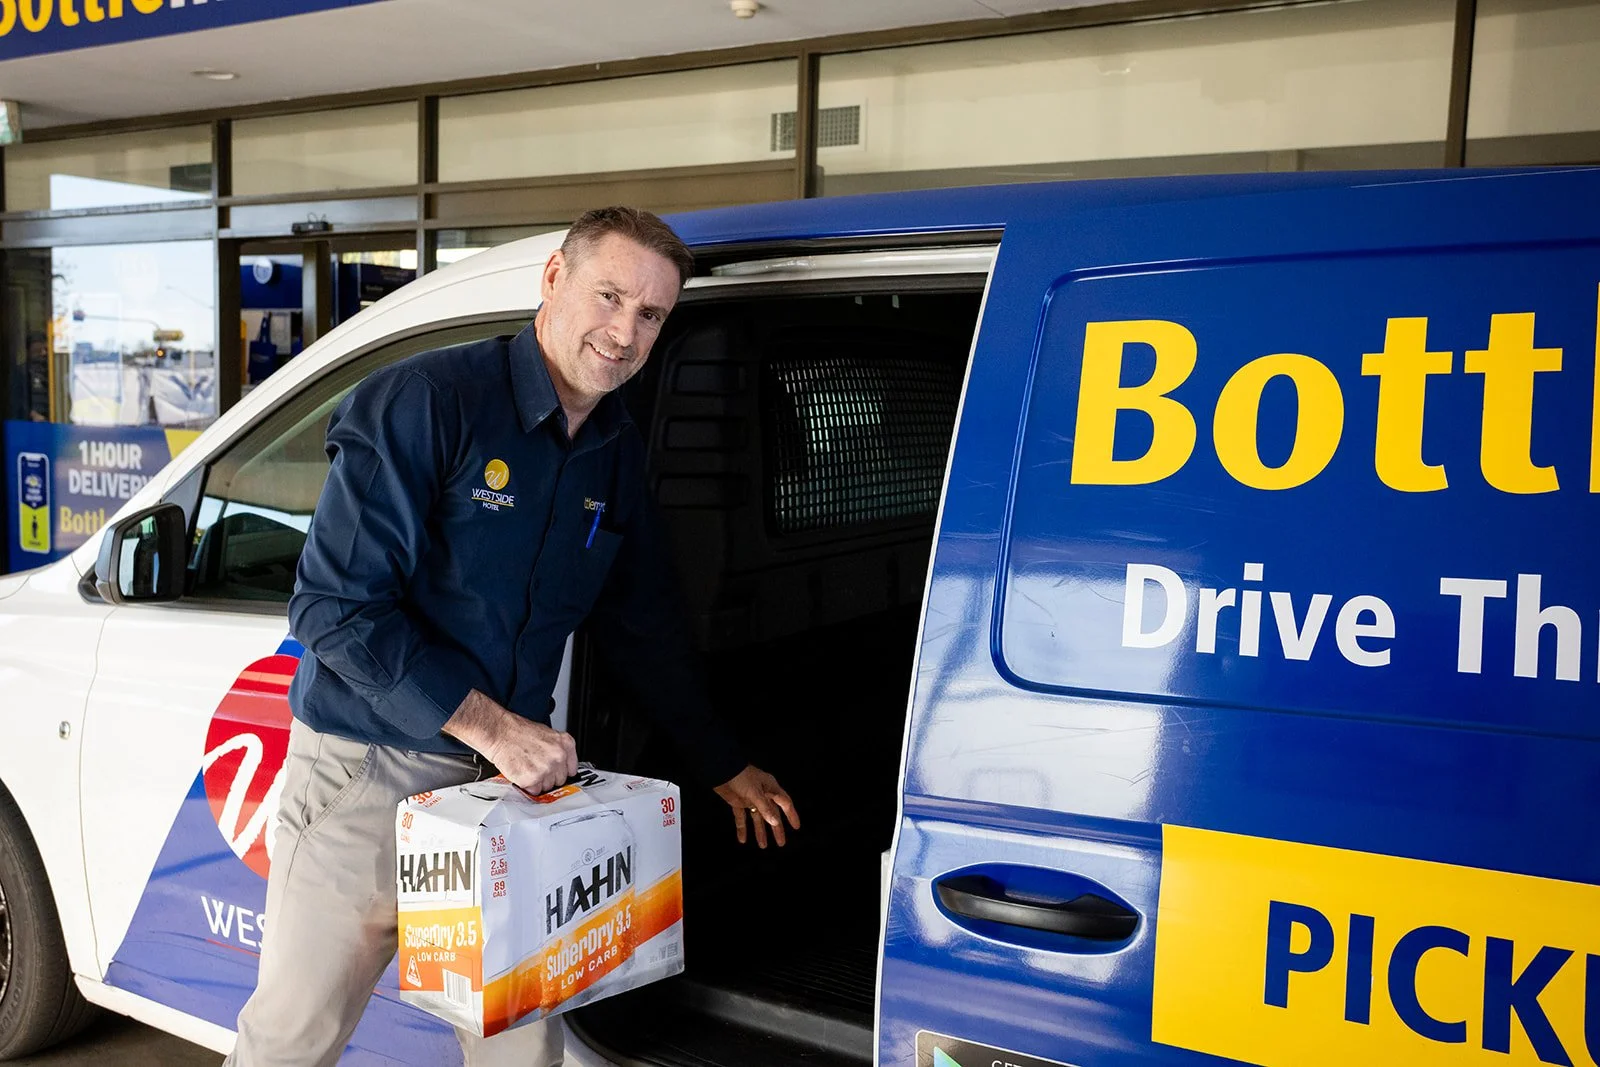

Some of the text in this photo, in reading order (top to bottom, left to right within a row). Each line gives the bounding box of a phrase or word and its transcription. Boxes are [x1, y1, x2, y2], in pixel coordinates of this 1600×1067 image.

[1070, 283, 1600, 495] Bott
[78, 440, 142, 470] 1 HOUR
[472, 488, 514, 505] WESTSIDE
[482, 501, 499, 511] HOTEL
[60, 505, 110, 536] Bottl
[1121, 562, 1600, 683] Drive Th
[401, 811, 414, 830] 30
[661, 796, 675, 814] 30
[490, 834, 505, 847] 3.5
[400, 850, 471, 893] HAHN
[494, 880, 505, 891] 89
[546, 845, 631, 936] HAHN
[404, 920, 477, 951] SuperDry 3.5
[546, 903, 631, 981] SuperDry 3.5
[417, 951, 456, 962] LOW CARB
[561, 945, 618, 990] LOW CARB
[1264, 900, 1600, 1067] PICK
